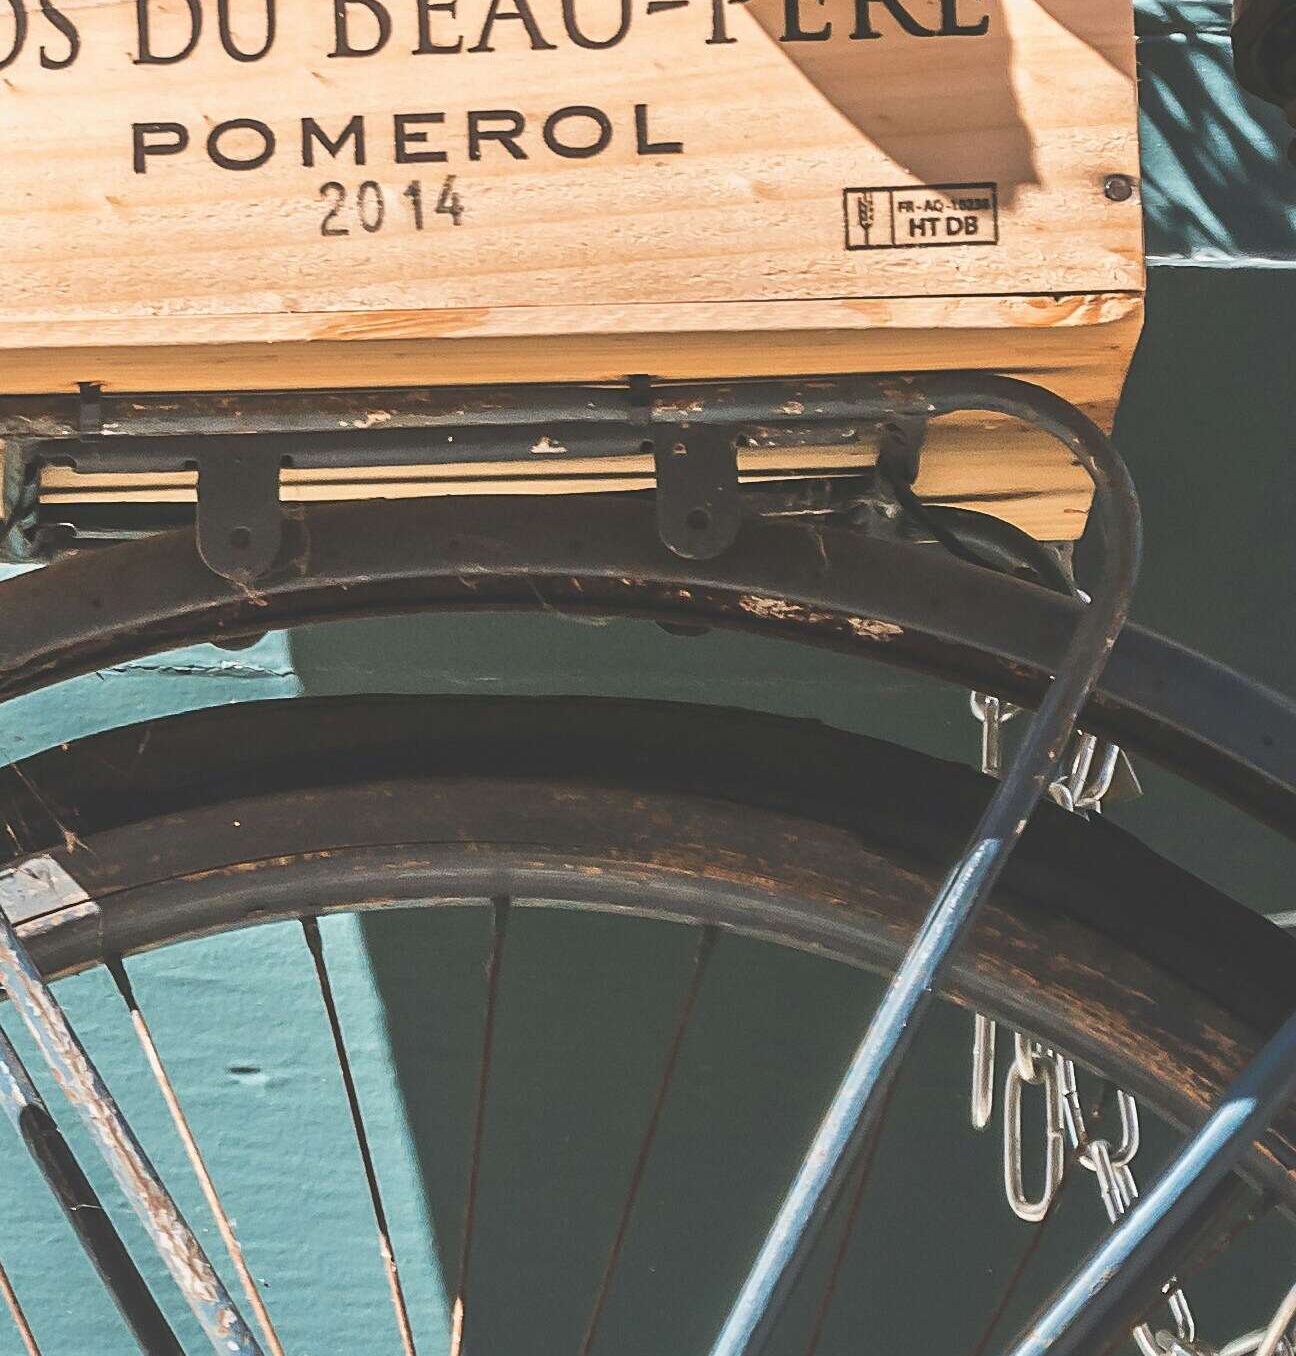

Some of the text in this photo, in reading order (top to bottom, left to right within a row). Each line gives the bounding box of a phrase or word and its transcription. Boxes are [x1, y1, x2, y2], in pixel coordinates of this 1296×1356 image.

[131, 104, 684, 175] POMEROL
[319, 174, 464, 237] 2014
[909, 216, 979, 237] HT DB
